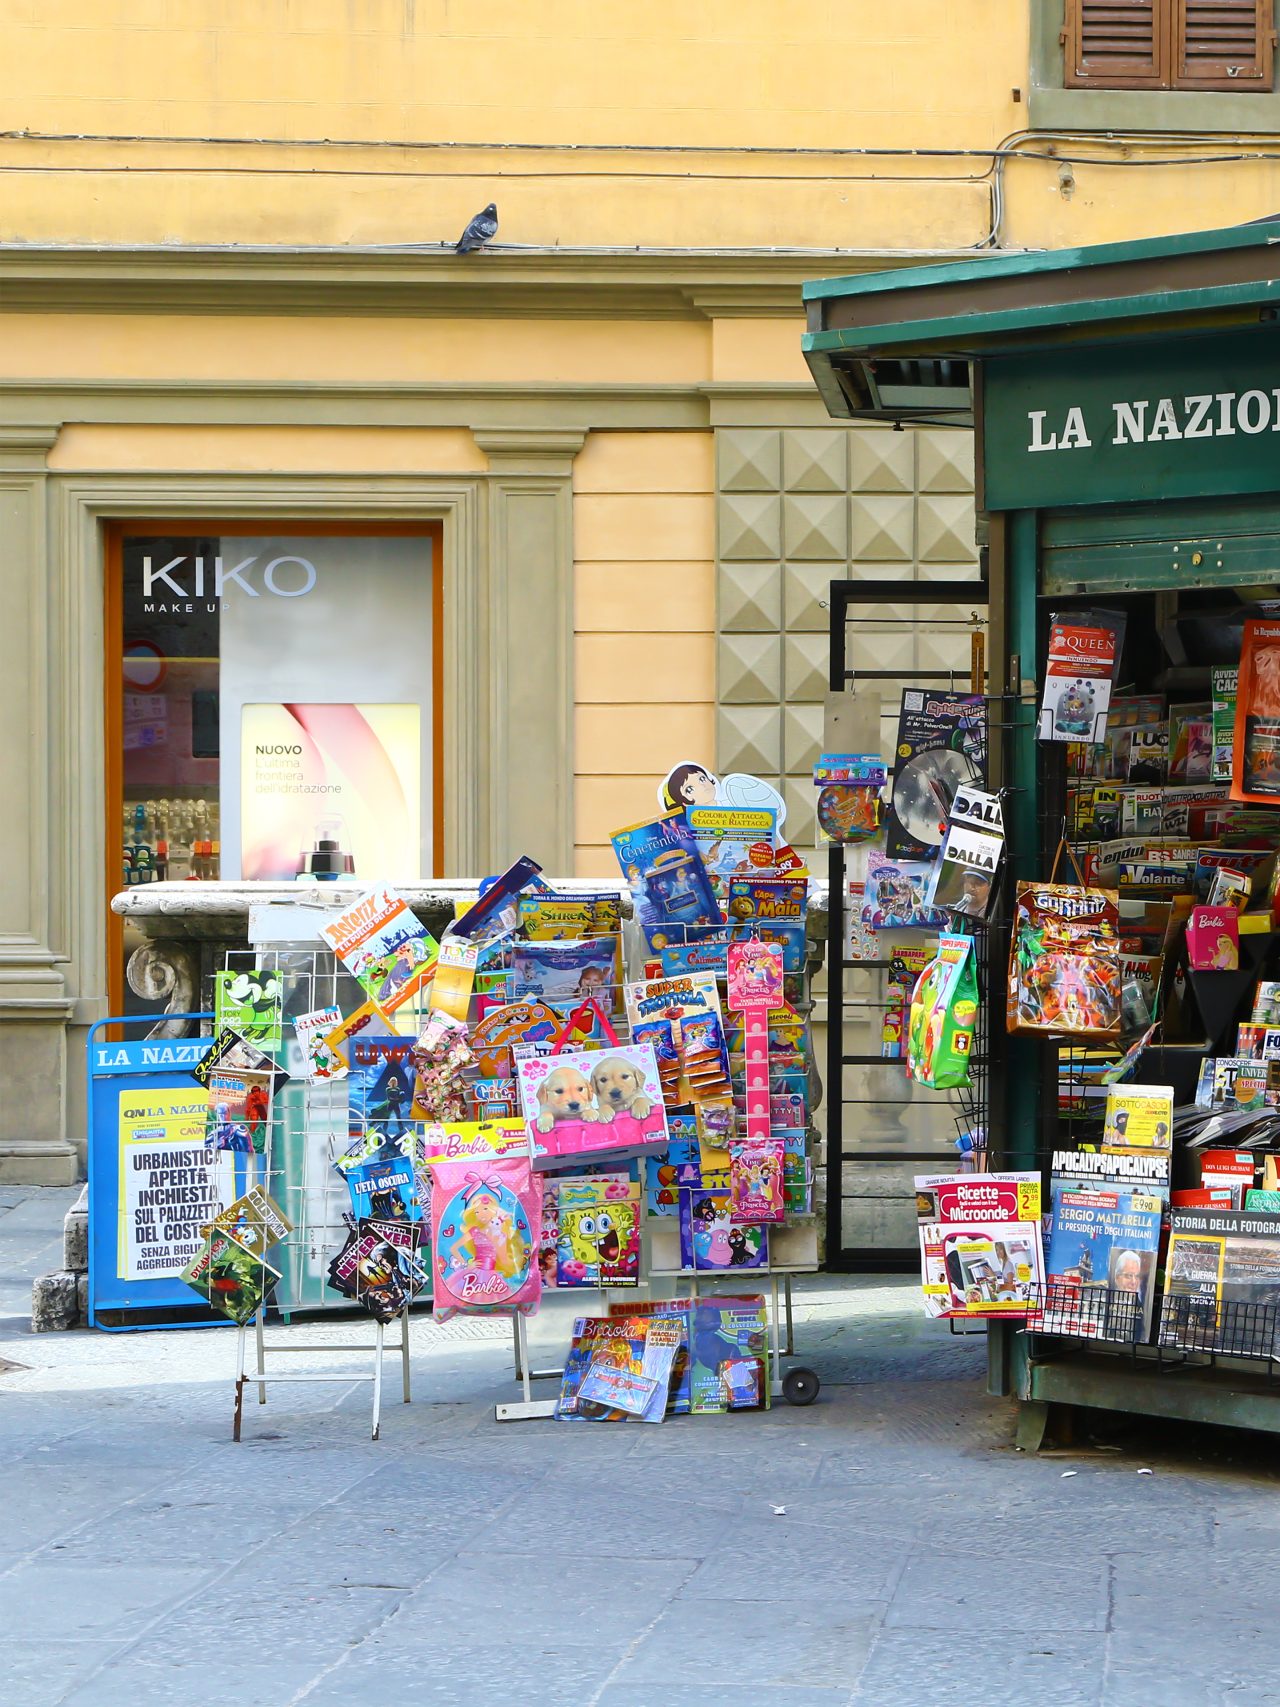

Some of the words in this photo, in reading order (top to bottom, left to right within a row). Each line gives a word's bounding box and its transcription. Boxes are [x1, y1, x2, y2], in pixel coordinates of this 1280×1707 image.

[1028, 407, 1092, 452] LA
[143, 556, 316, 597] KIKO
[144, 604, 193, 612] MAKE
[207, 604, 231, 612] UP
[1066, 636, 1116, 653] QUEEN
[255, 745, 302, 755] NUOVO
[255, 758, 300, 769] L'ultima
[255, 771, 304, 782] frontiera
[818, 769, 850, 780] PLAY
[851, 768, 885, 780] TOYS
[255, 784, 342, 794] dell'idratazione
[1098, 792, 1116, 801] IN
[729, 819, 769, 827] RIATTACCA
[619, 831, 688, 864] Cenerentola
[948, 846, 994, 870] DALLA
[1120, 865, 1185, 884] alVolante
[758, 899, 800, 918] Maia
[325, 895, 379, 945] Asterix
[1199, 915, 1225, 928] Barbie
[441, 944, 476, 960] TOYS
[647, 978, 694, 998] SUPER
[638, 991, 708, 1018] TROTTOLA
[1115, 1099, 1168, 1110] SOTTOCASCO
[446, 1134, 491, 1157] Barbie
[133, 1150, 223, 1171] URBANISTICA
[1107, 1154, 1168, 1178] APOCALYPSE
[149, 1168, 208, 1188] APERTA
[378, 1173, 410, 1189] OSCURA
[138, 1186, 217, 1207] INCHIESTA
[957, 1185, 999, 1200] Ricette
[135, 1208, 155, 1226] SUL
[950, 1206, 1009, 1221] Microonde
[1060, 1208, 1095, 1221] SERGIO
[1096, 1212, 1153, 1227] MATTARELLA
[1058, 1222, 1065, 1230] IL
[1066, 1222, 1103, 1234] PRESIDENTE
[1104, 1225, 1124, 1236] DEGLI
[1125, 1227, 1152, 1239] ITALIANI
[1174, 1216, 1207, 1230] STORIA
[1209, 1218, 1238, 1232] DELLA
[541, 1229, 559, 1240] 20
[336, 1235, 379, 1280] NEVER
[1191, 1270, 1217, 1281] GUERRA
[462, 1273, 508, 1296] Barbie
[1199, 1283, 1216, 1293] ALLA
[610, 1301, 667, 1315] COMBATTI
